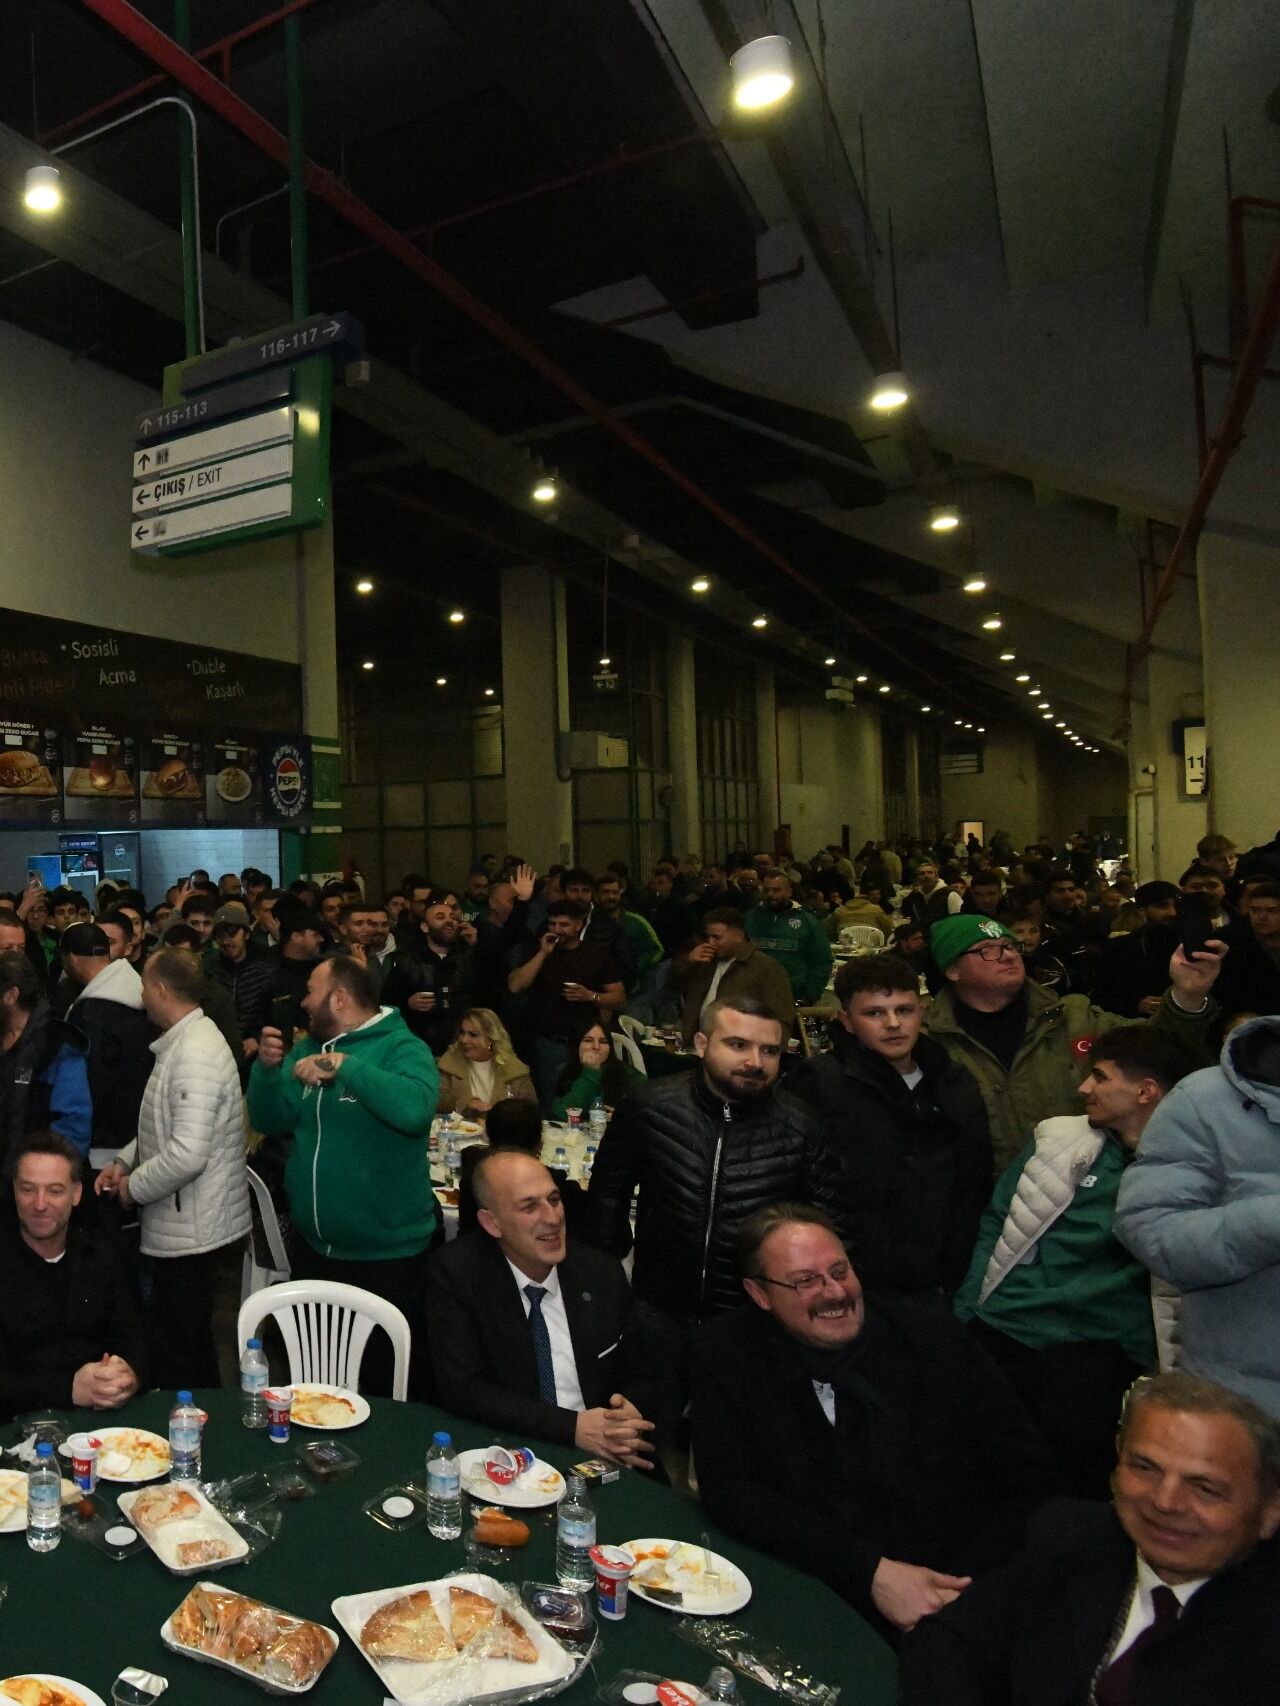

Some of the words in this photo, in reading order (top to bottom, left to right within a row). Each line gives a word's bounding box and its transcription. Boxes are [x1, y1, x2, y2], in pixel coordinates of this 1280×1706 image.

[260, 327, 318, 359] 116-117
[156, 401, 208, 428] 115-113
[154, 477, 185, 501] ÇIKIŞ
[197, 467, 223, 487] EXIT
[71, 638, 120, 660] Sosisli
